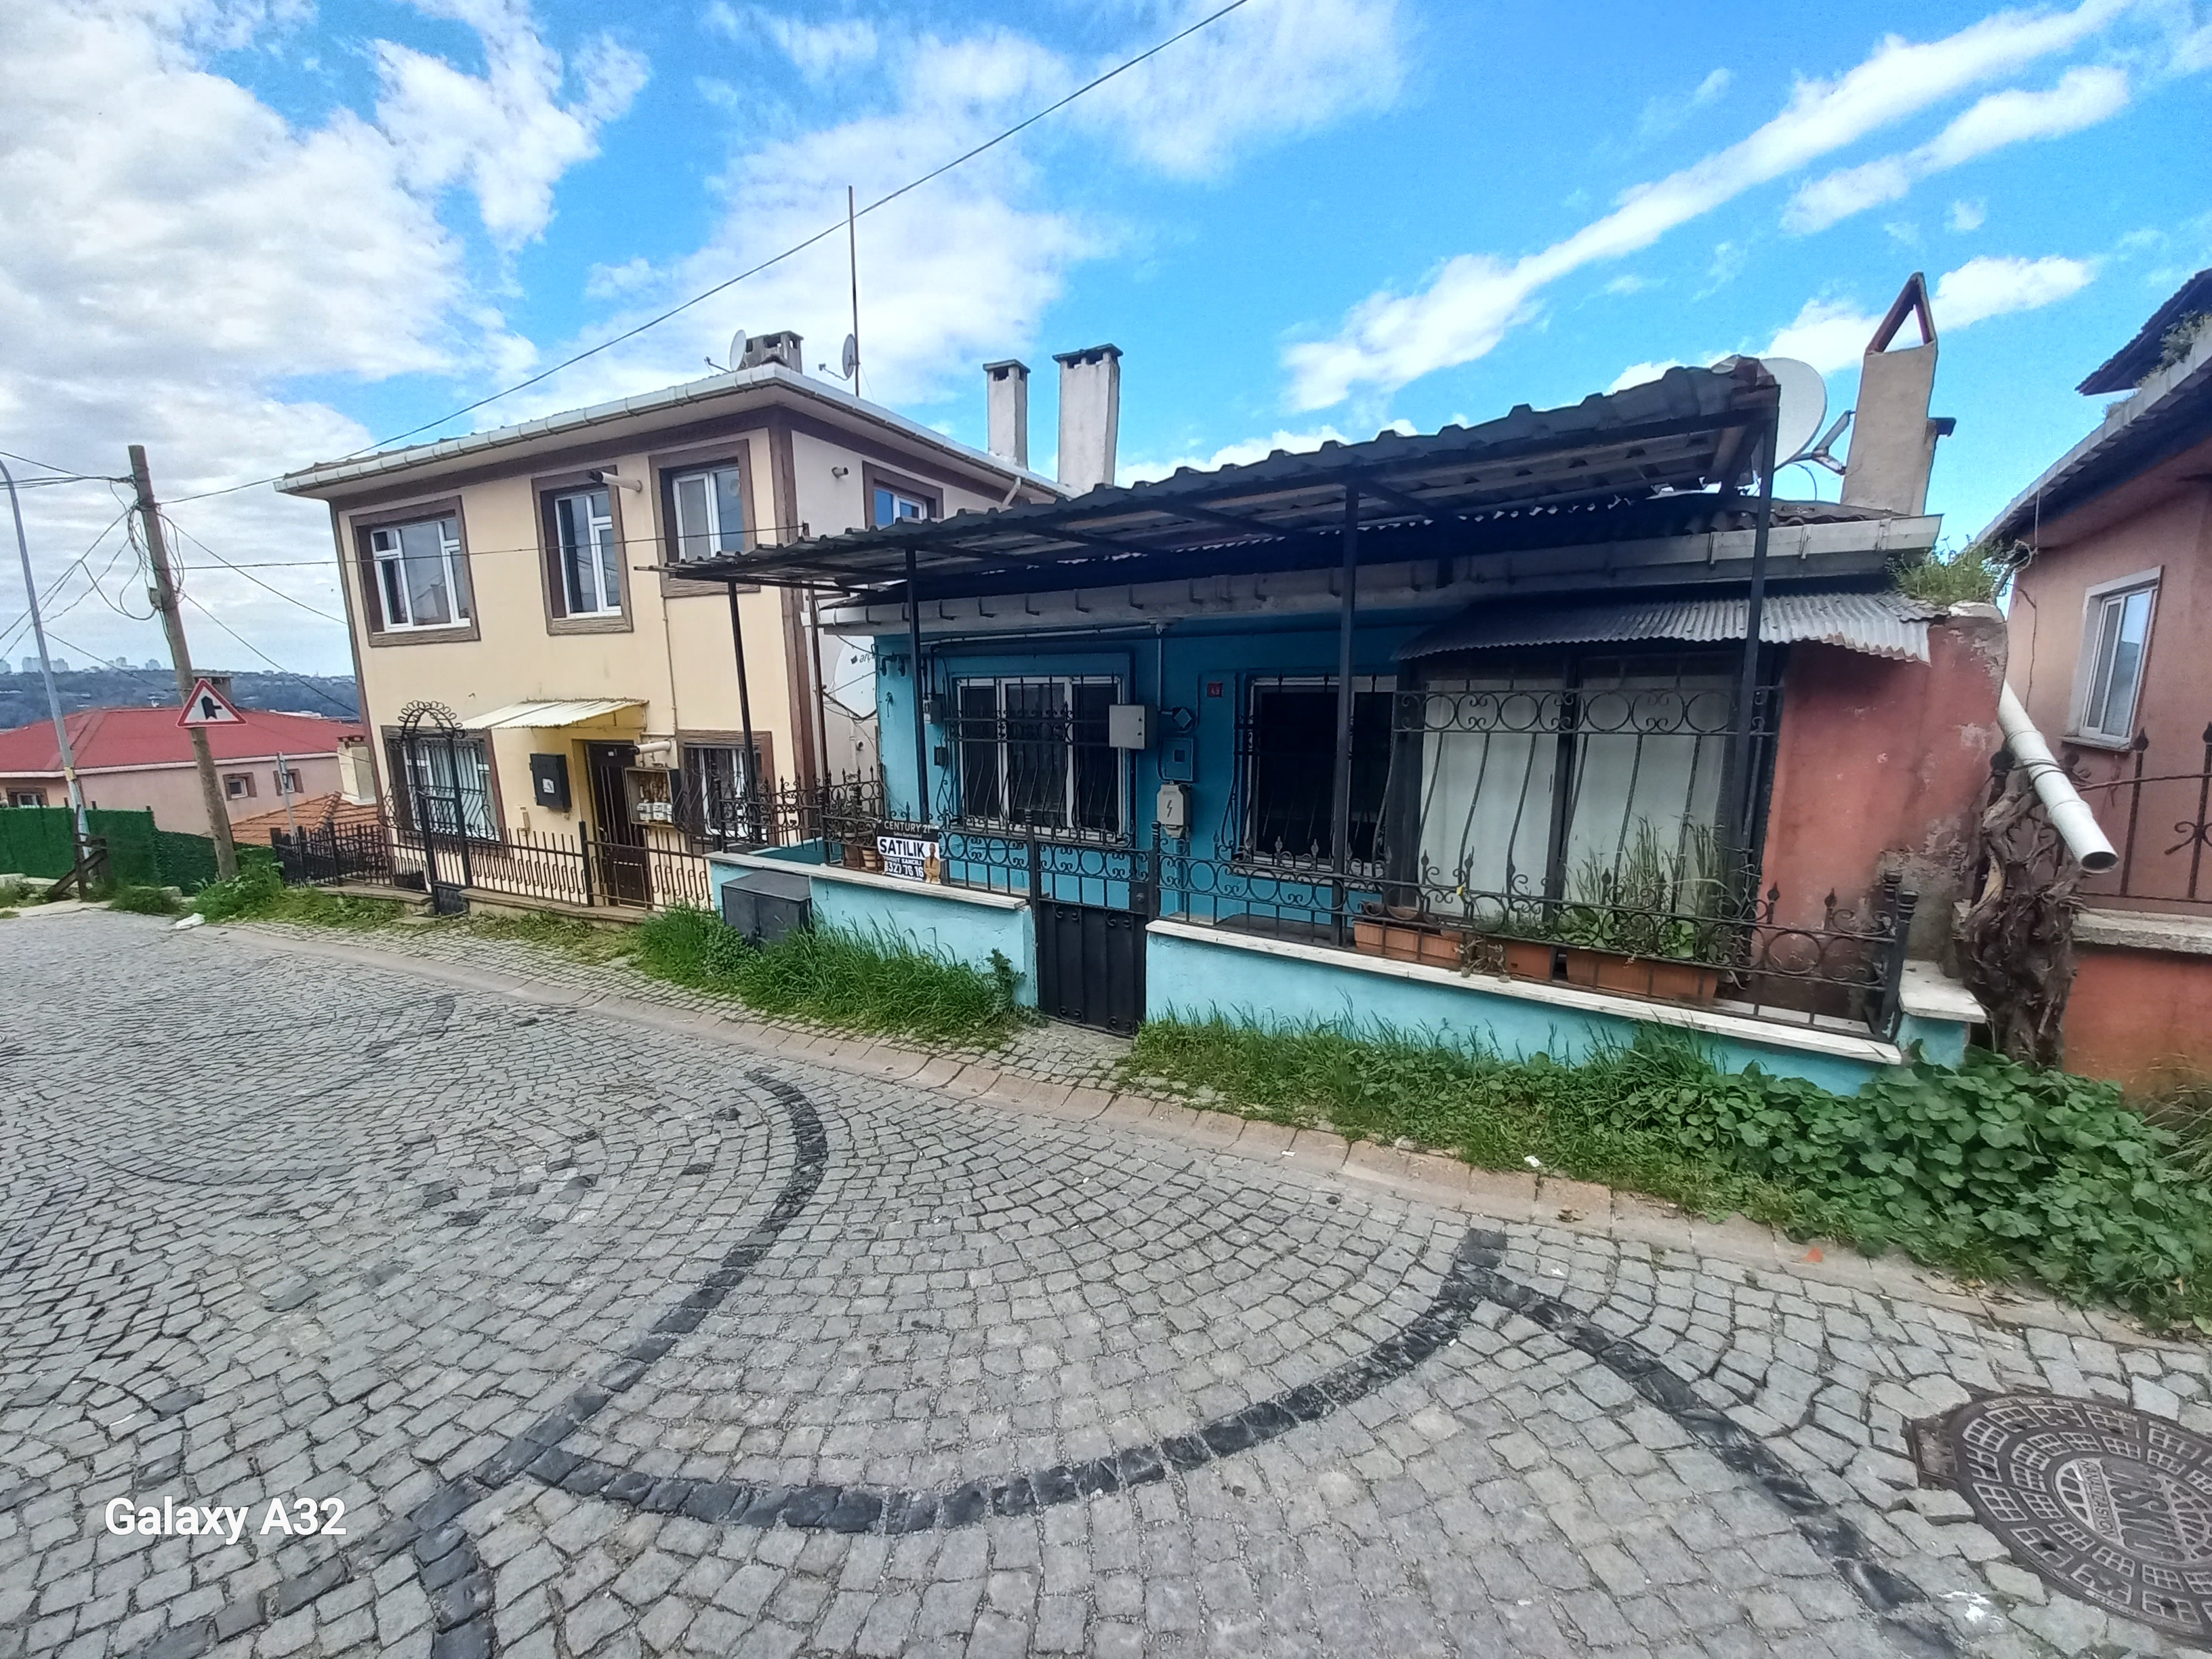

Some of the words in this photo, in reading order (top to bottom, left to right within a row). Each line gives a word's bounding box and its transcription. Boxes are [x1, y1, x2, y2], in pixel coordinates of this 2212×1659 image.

[884, 821, 922, 832] CENTURY
[922, 825, 930, 834] 21
[880, 838, 925, 857] SATILIK
[903, 865, 914, 876] 76
[914, 865, 924, 878] 16
